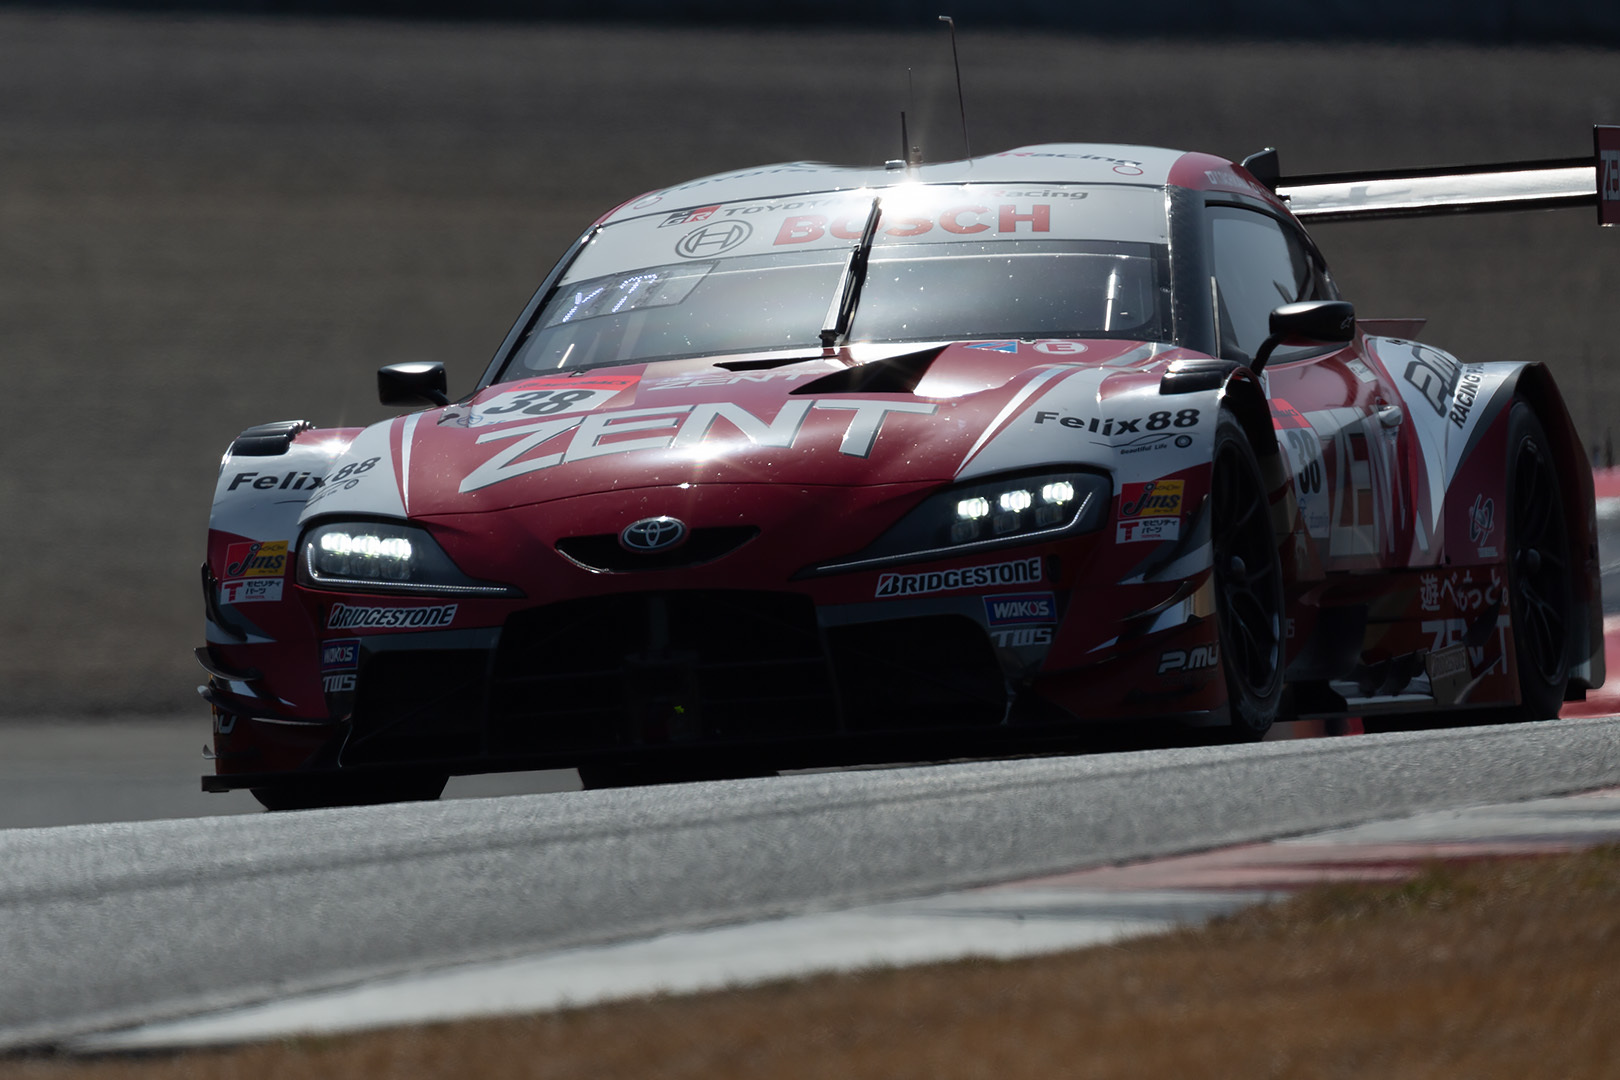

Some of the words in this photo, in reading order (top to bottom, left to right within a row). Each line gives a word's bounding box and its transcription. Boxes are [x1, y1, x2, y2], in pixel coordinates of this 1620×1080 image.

[482, 390, 597, 415] 38
[1449, 374, 1481, 430] RACING
[1034, 409, 1200, 437] Felix88
[459, 398, 938, 493] ZENT
[227, 457, 382, 491] Felix88
[877, 557, 1042, 597] BRIDGESTONE
[328, 603, 458, 628] BRIDGESTONE
[990, 628, 1052, 648] TWS
[323, 674, 357, 693] TWS
